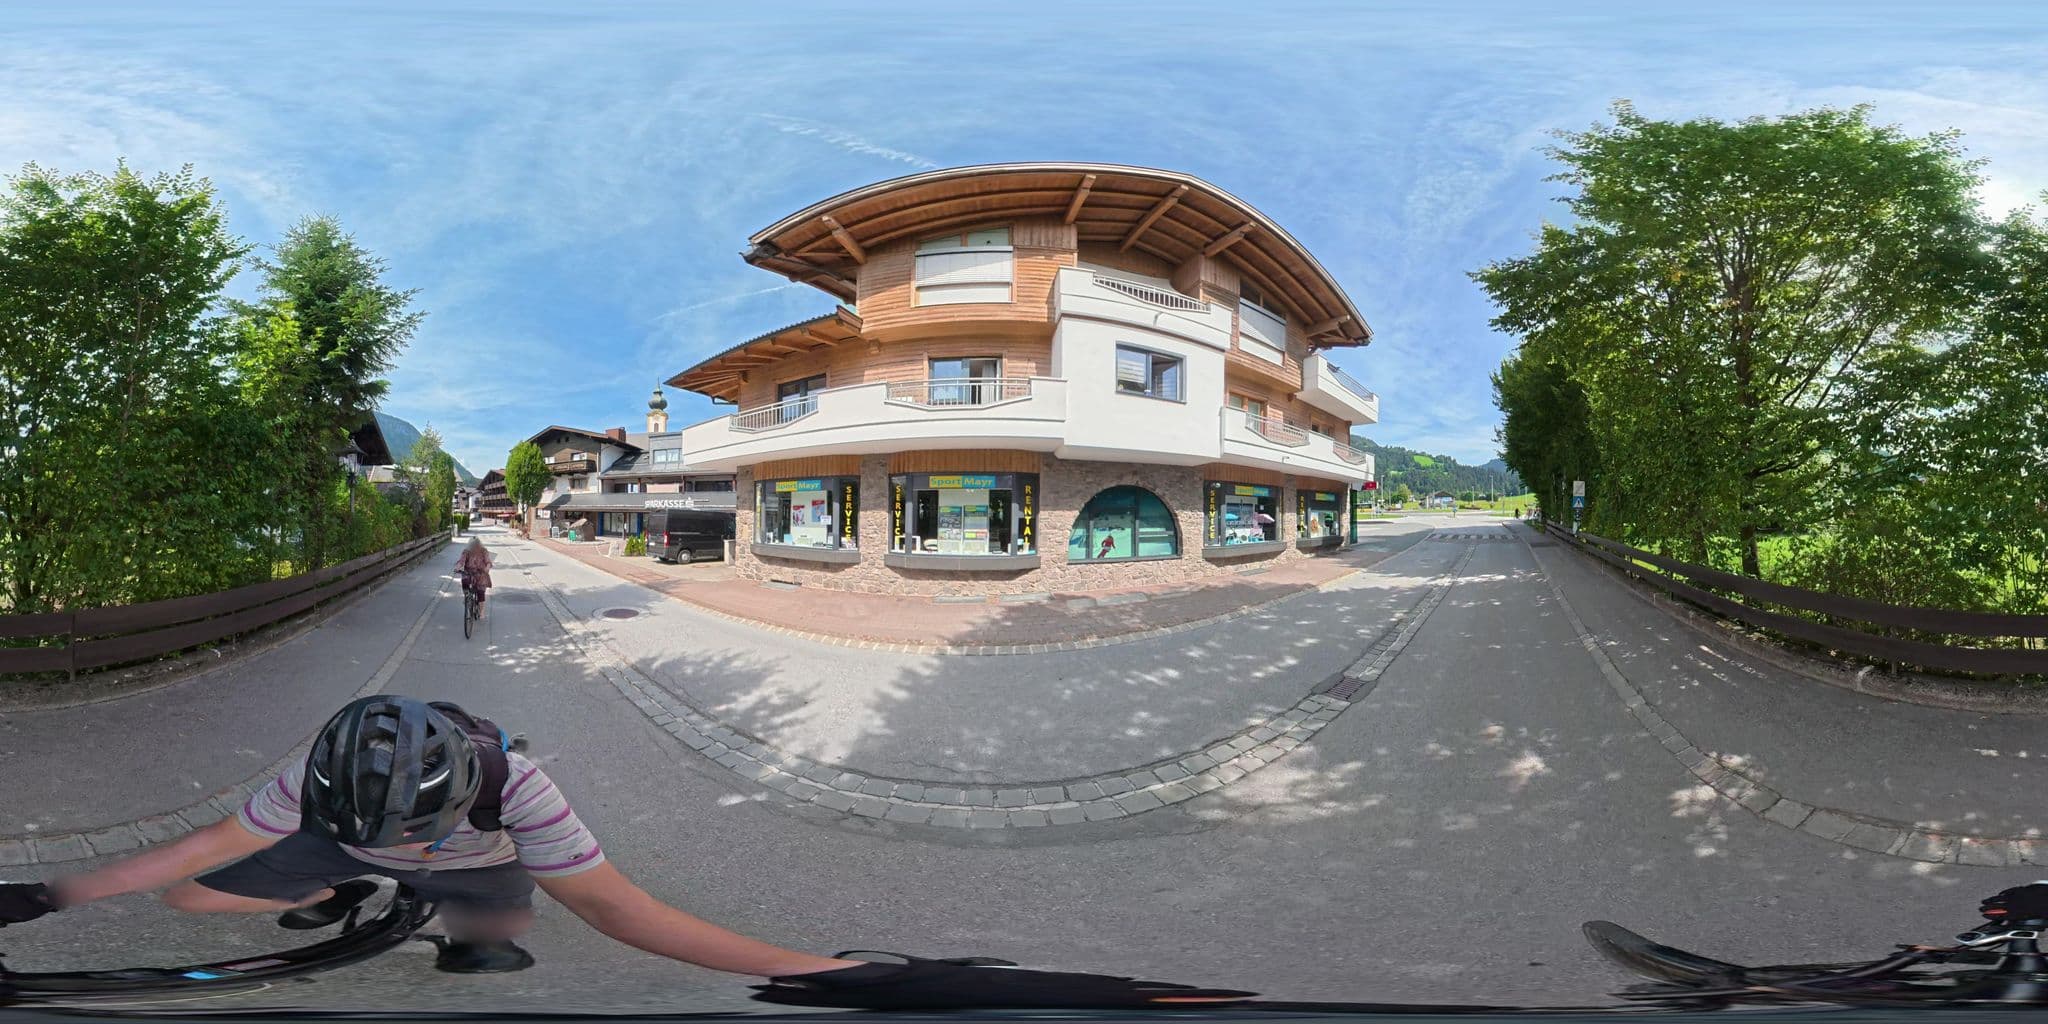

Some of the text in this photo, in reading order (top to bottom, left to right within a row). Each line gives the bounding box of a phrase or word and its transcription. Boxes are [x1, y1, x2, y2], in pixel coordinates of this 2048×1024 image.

[931, 476, 993, 488] Sport Mayr
[1024, 485, 1032, 544] RENTAL
